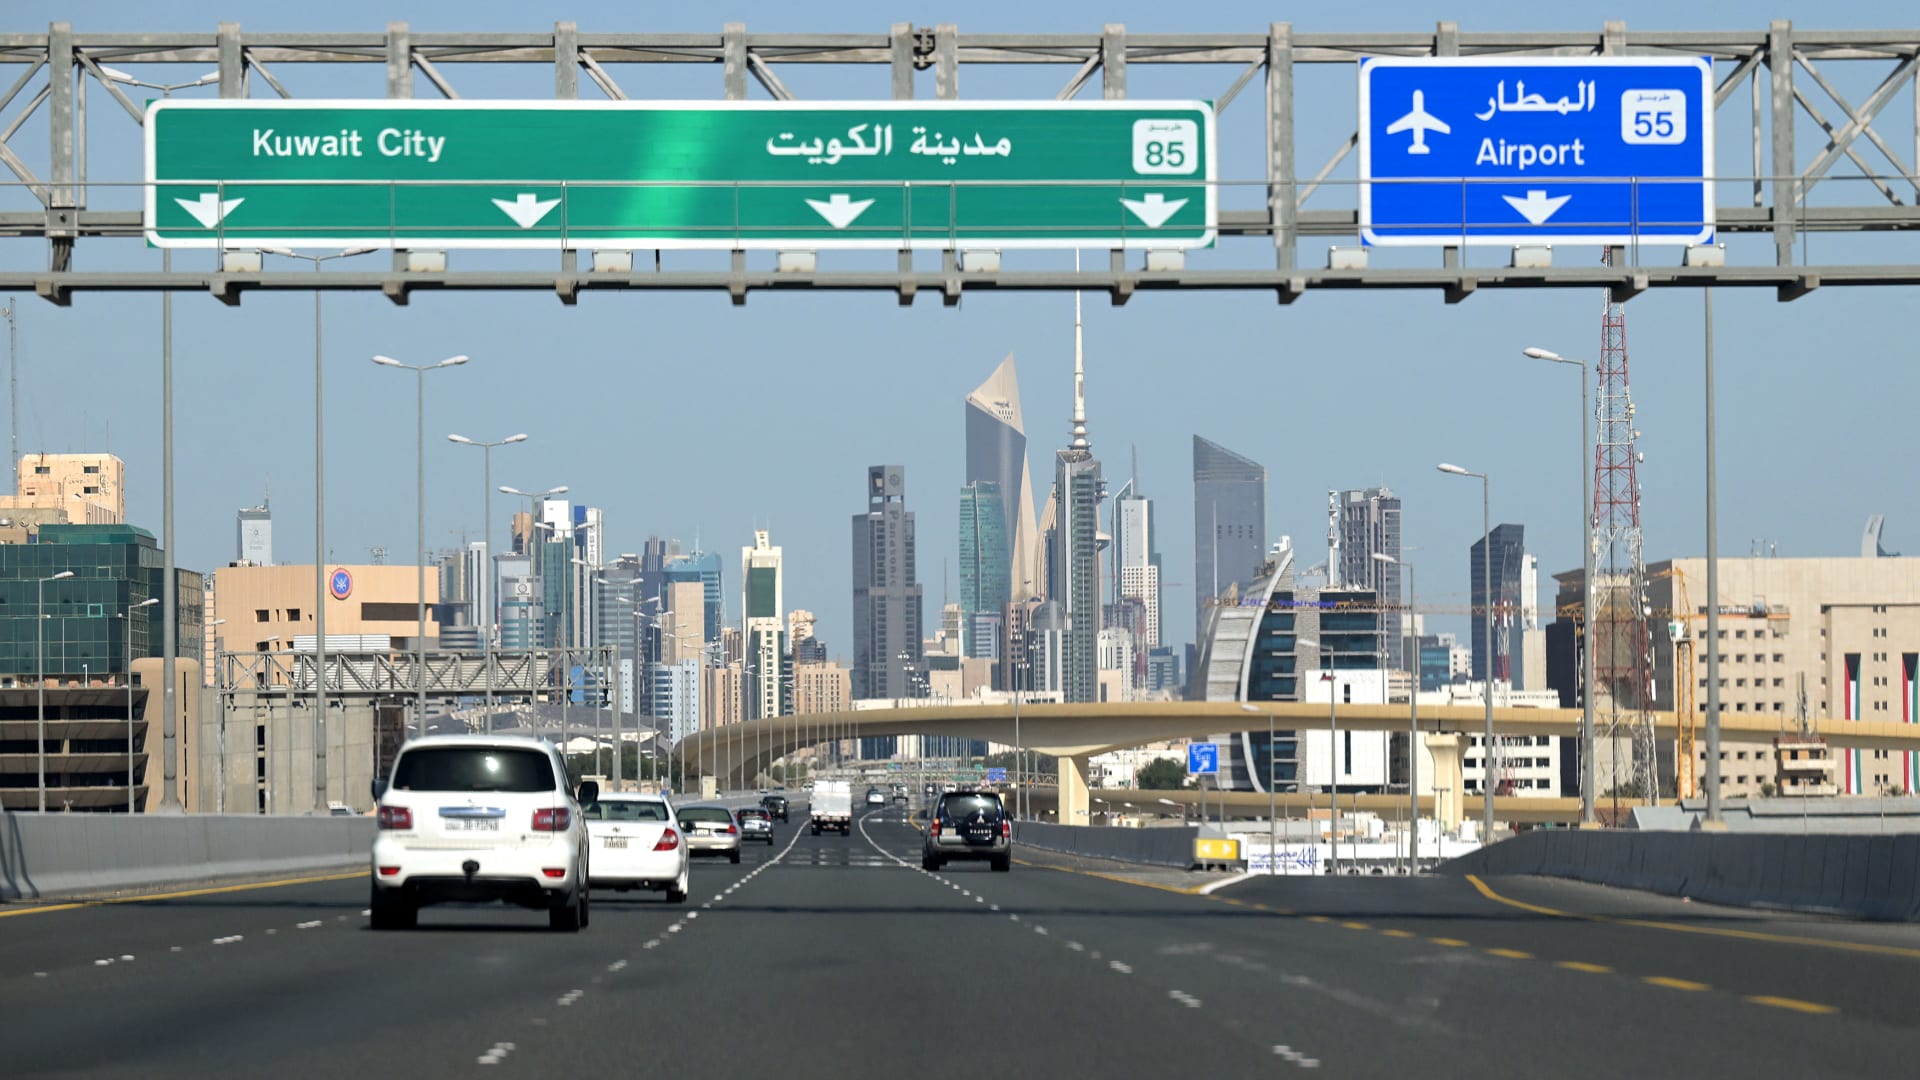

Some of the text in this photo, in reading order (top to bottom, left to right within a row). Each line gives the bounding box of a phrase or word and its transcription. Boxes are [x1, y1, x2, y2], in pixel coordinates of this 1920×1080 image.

[1475, 79, 1596, 121] المطار
[1634, 111, 1674, 138] 55
[253, 127, 446, 163] Kuwait City
[766, 123, 1012, 165] مدينة الكويت
[1145, 140, 1185, 168] 85
[1475, 137, 1585, 170] Airport
